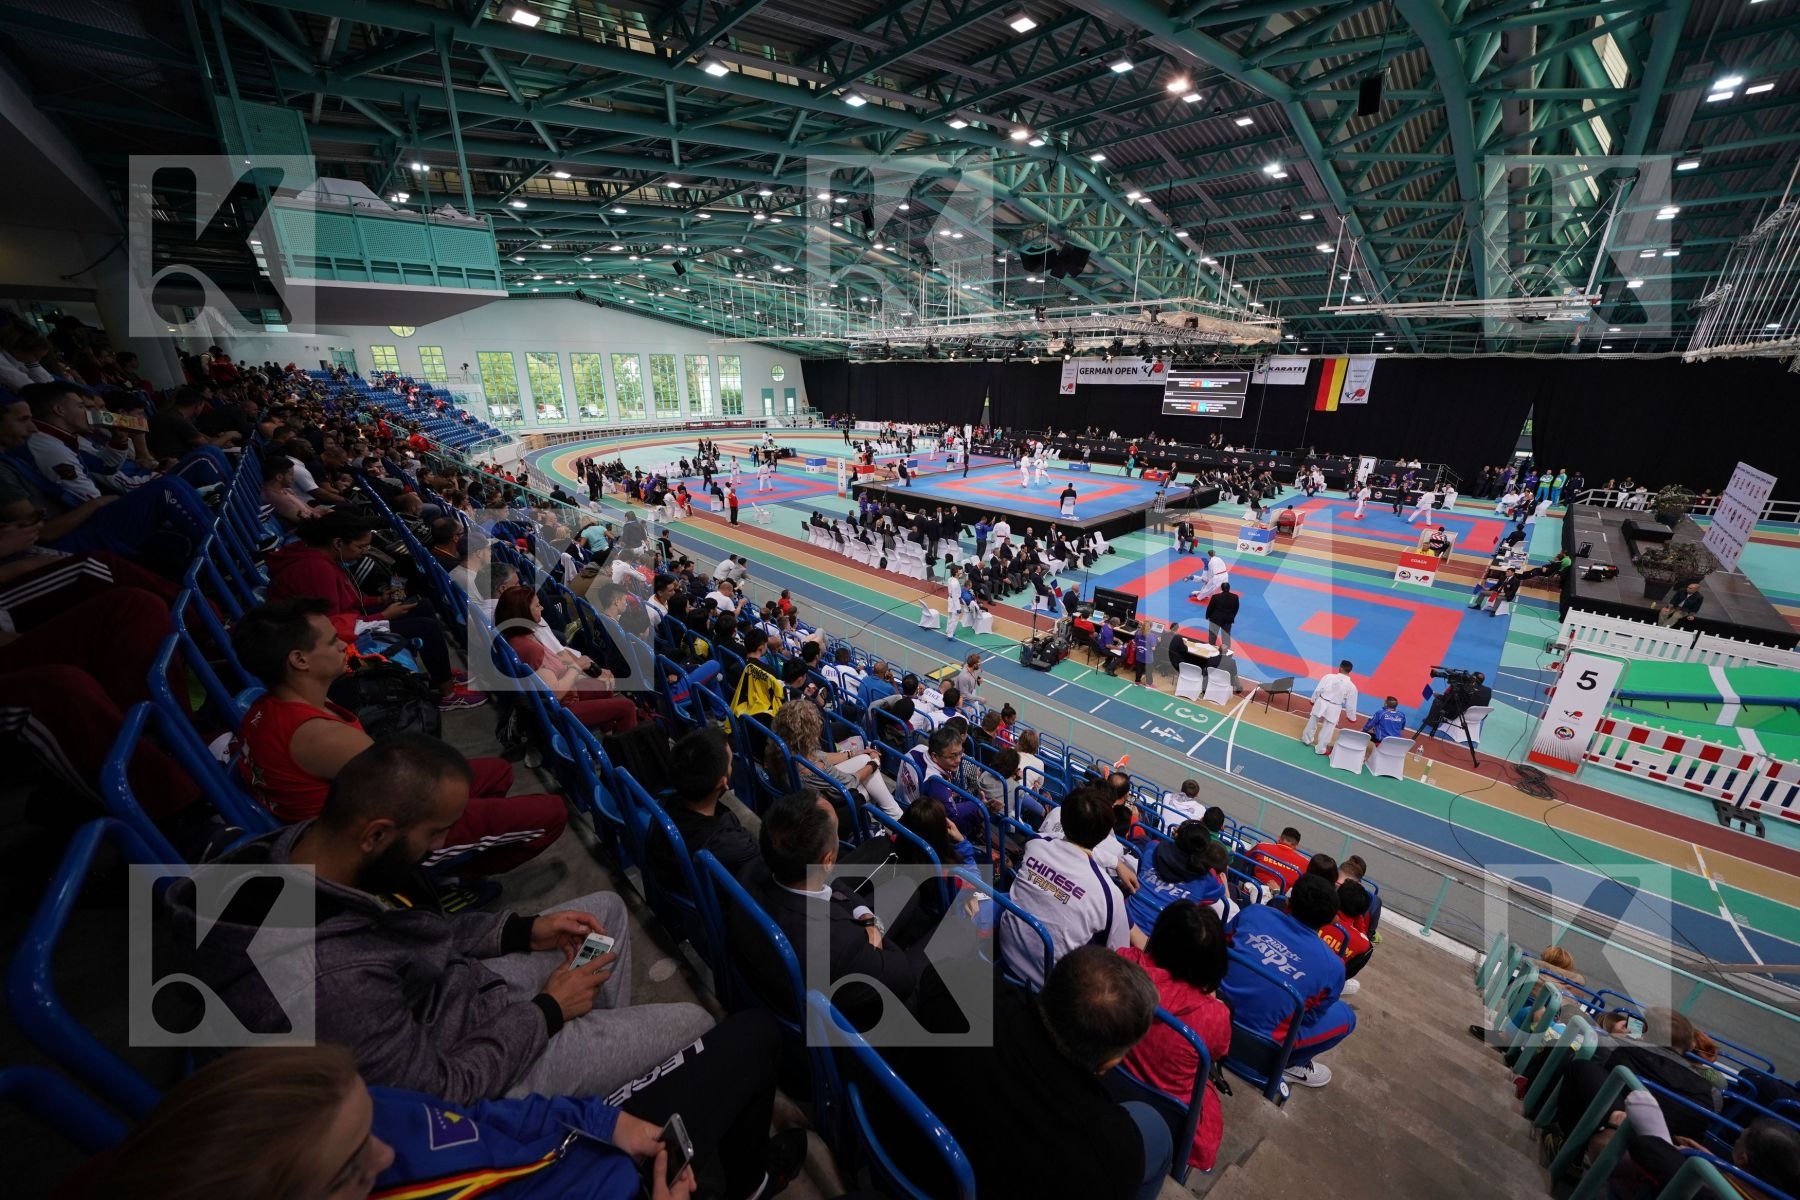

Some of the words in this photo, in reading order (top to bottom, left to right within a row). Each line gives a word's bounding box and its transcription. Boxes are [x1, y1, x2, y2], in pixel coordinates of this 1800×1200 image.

[1079, 367, 1113, 375] GERMAN
[1115, 367, 1138, 375] OPEN
[1576, 670, 1599, 690] 5
[1026, 856, 1086, 900] CHINESE
[1027, 868, 1071, 904] TAIPEI
[1244, 932, 1306, 980] TAIPEI
[603, 1037, 705, 1107] LEGE
